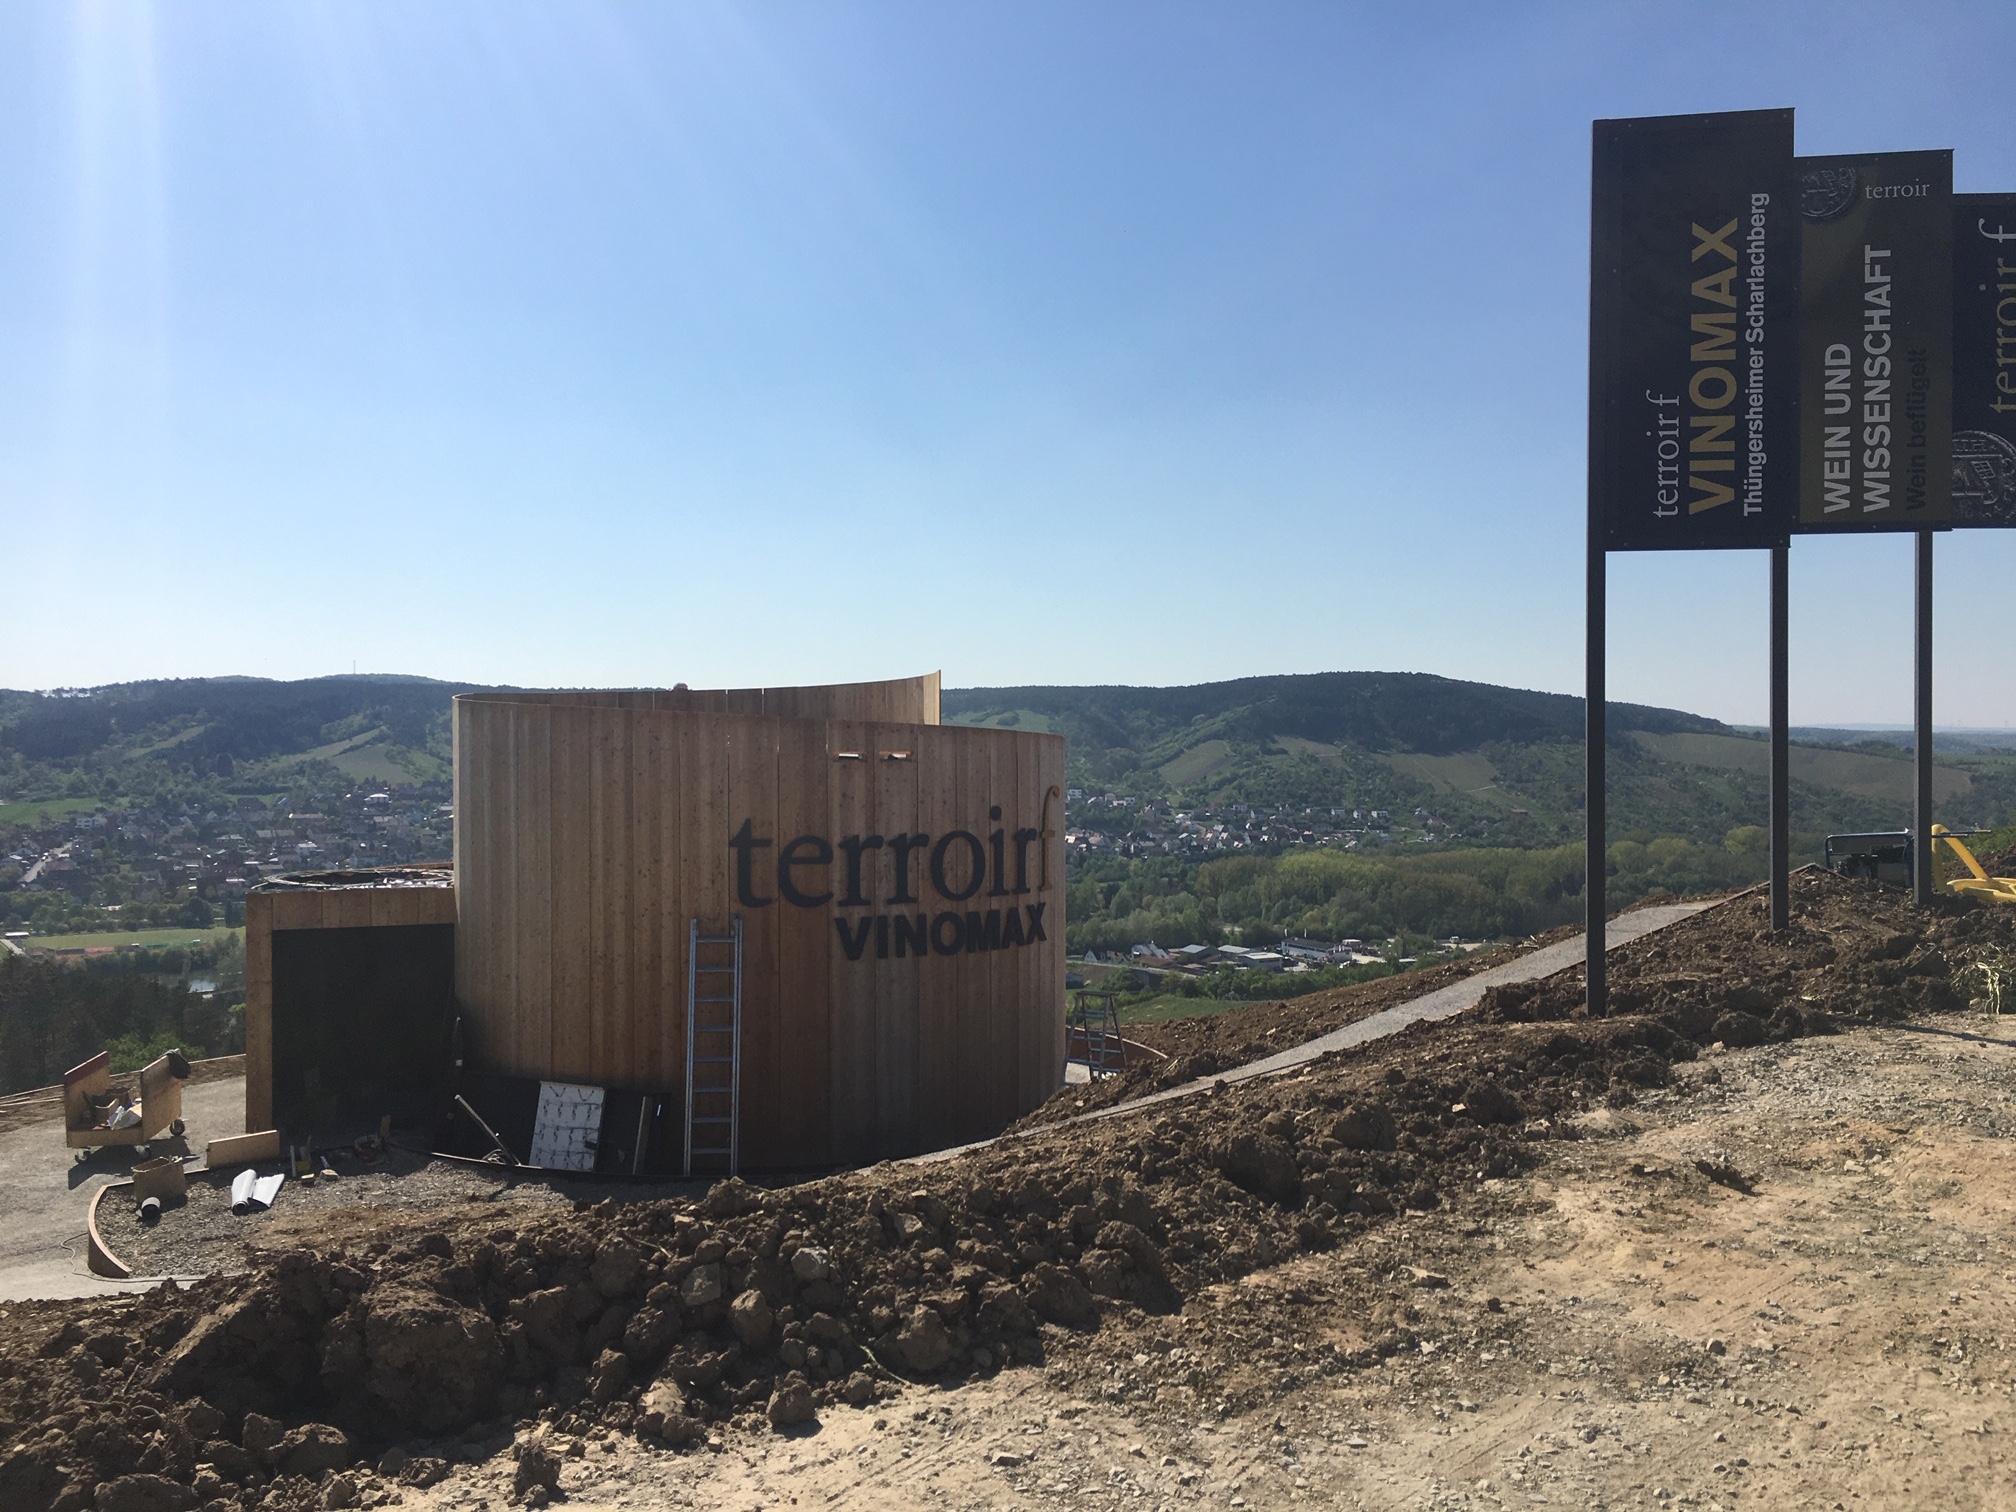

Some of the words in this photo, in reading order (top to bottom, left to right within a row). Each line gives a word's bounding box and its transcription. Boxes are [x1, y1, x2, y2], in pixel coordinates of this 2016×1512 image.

[1865, 178, 1930, 199] terroir
[1745, 193, 1769, 343] Scharlachberg
[1646, 389, 1679, 406] f
[1688, 217, 1738, 515] VINOMAX
[1824, 343, 1852, 415] UND
[1863, 244, 1892, 512] WISSENSCHAFT
[1906, 348, 1930, 449] beflügelt
[1646, 413, 1679, 518] terroir
[1743, 347, 1767, 517] Thüngersheimer
[1824, 426, 1851, 513] WEIN
[1906, 454, 1927, 512] Wein
[834, 901, 1048, 961] VINOMAX
